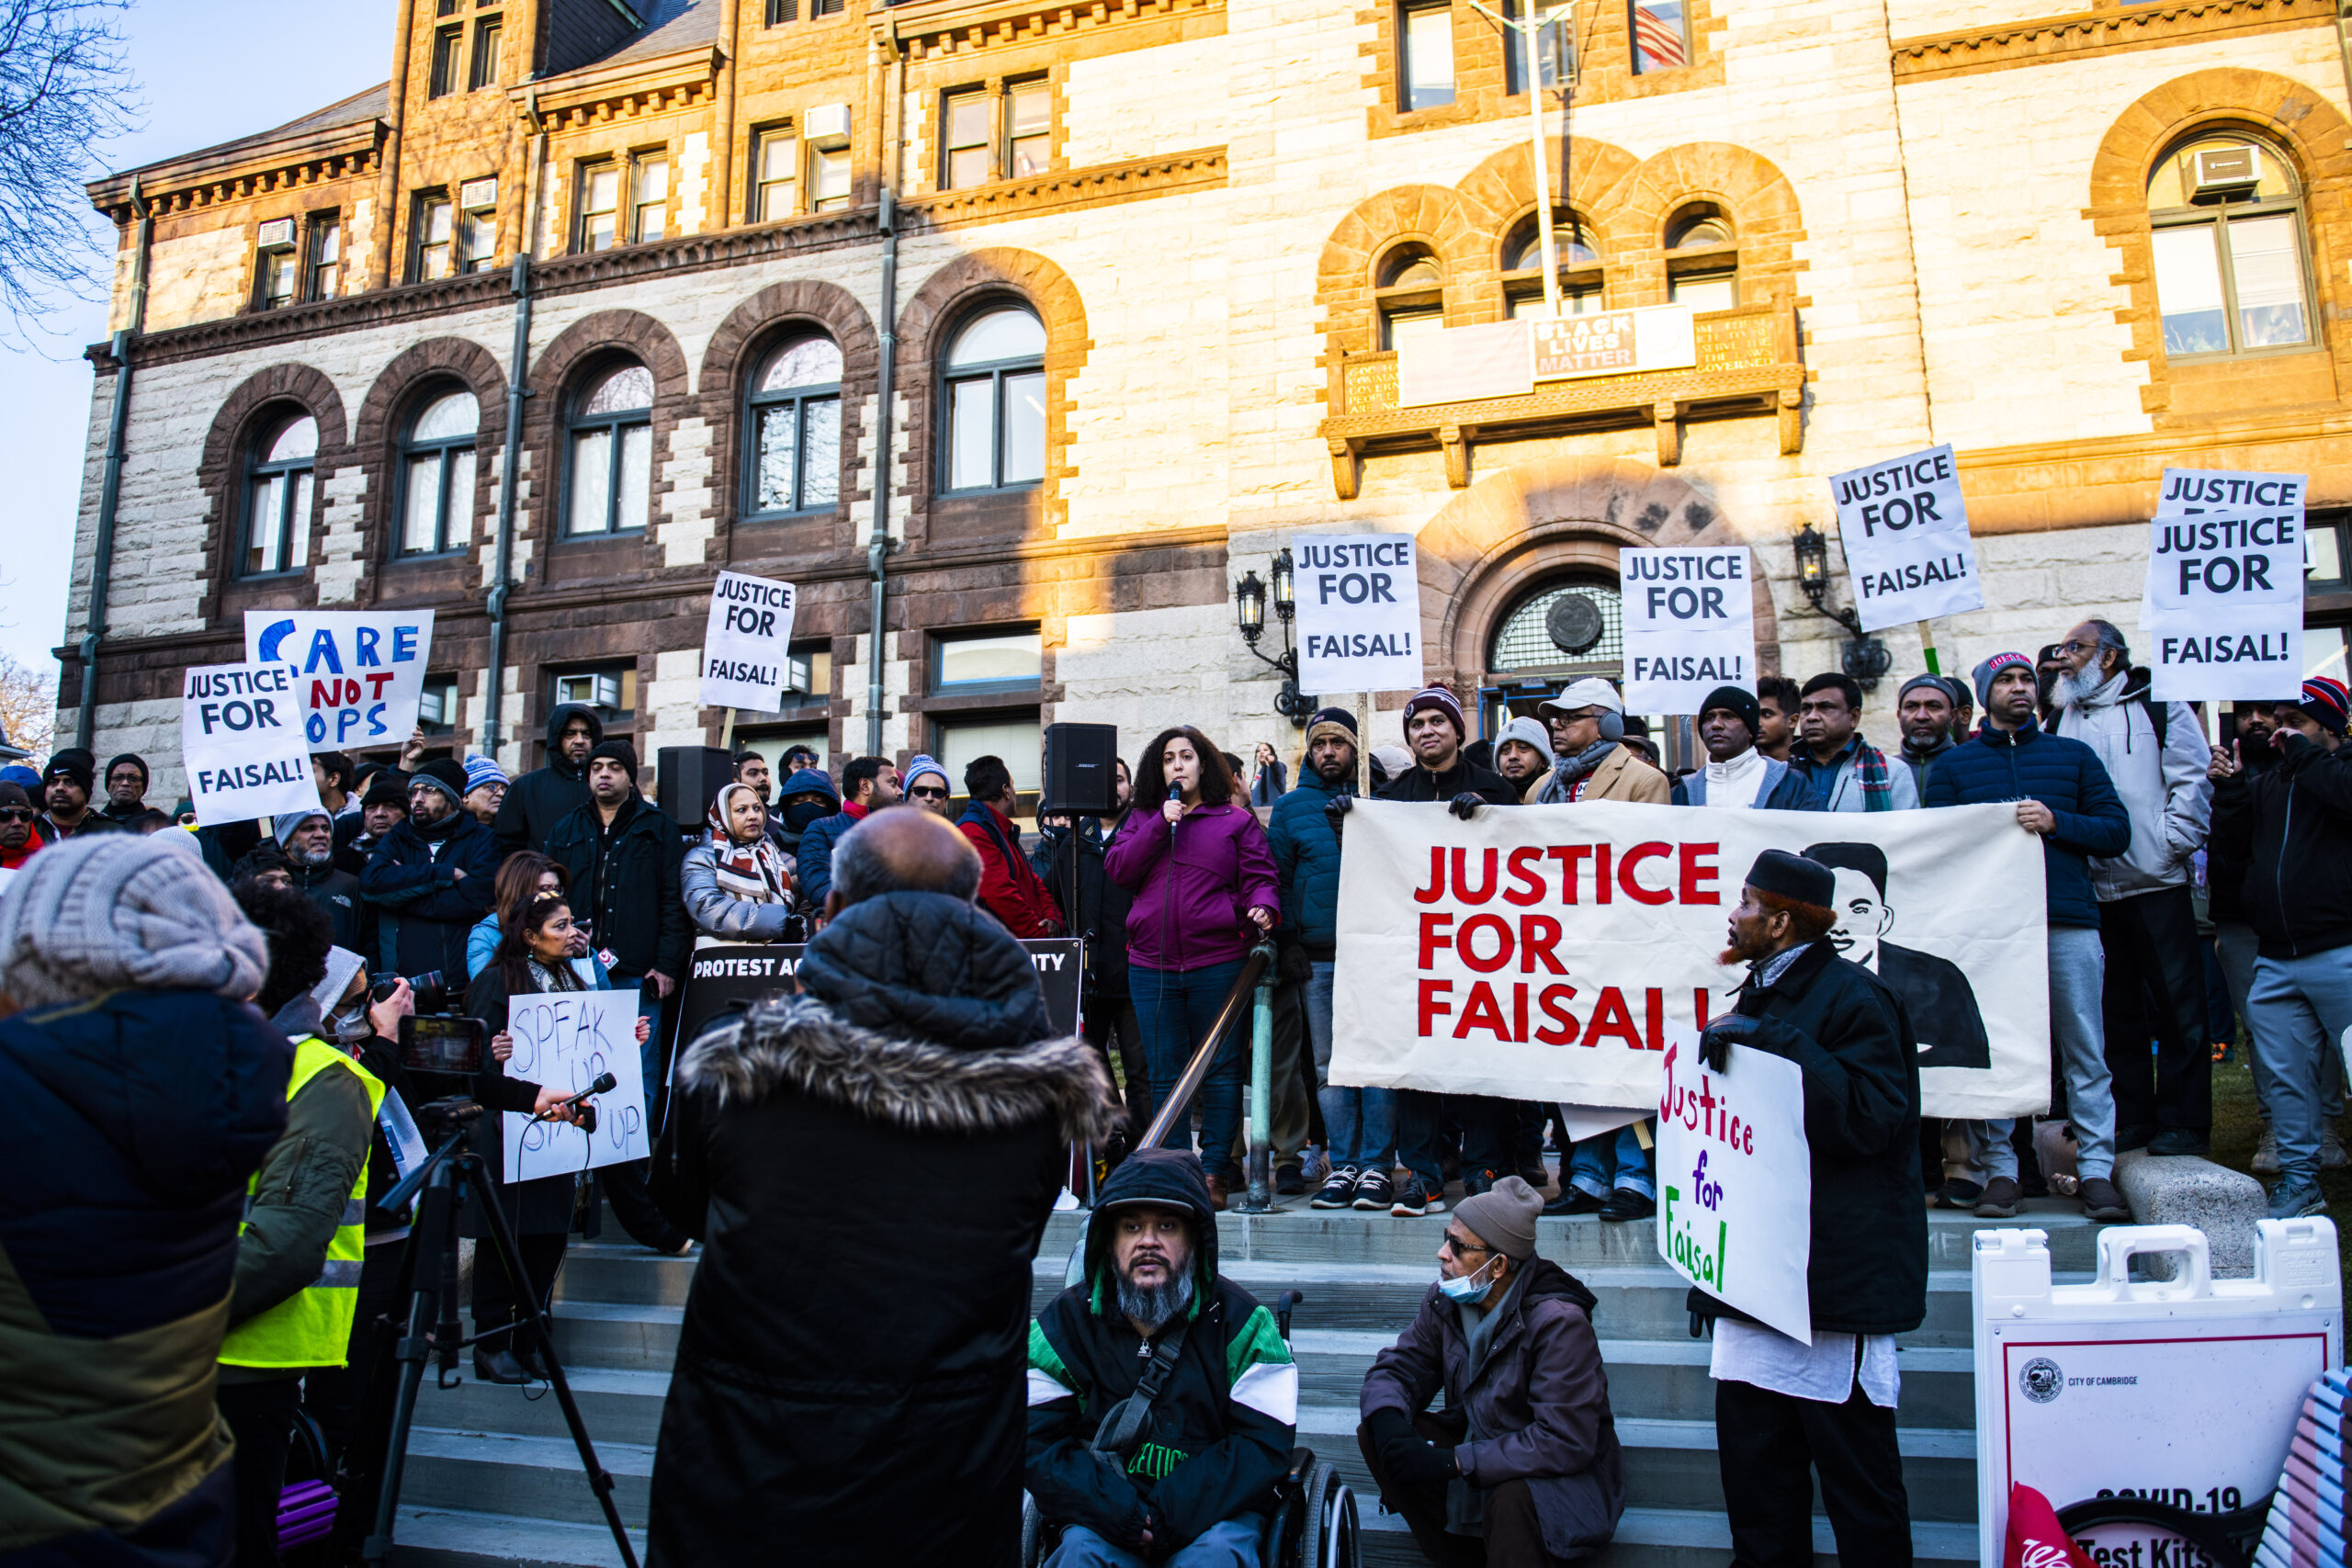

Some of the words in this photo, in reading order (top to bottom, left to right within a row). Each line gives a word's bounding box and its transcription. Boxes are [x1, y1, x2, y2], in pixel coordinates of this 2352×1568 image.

[1537, 316, 1631, 340] BLACK
[1549, 333, 1619, 355] LIVES
[1539, 349, 1632, 373] MATTER
[1696, 357, 1774, 374] GOVERNED
[1840, 454, 1951, 505] JUSTICE
[2165, 477, 2298, 507] JUSTICE
[1861, 491, 1943, 537] FOR
[2156, 515, 2294, 555] JUSTICE
[1298, 542, 1409, 569] JUSTICE
[1626, 556, 1742, 581] JUSTICE
[1318, 572, 1396, 604] FOR
[1860, 553, 1967, 599] FAISAL!
[2179, 554, 2274, 595] FOR
[718, 579, 792, 609] JUSTICE
[1647, 586, 1728, 619] FOR
[725, 604, 775, 637] FOR
[258, 619, 419, 677] CARE
[1307, 632, 1412, 659] FAISAL!
[2163, 632, 2289, 664] FAISAL!
[187, 669, 288, 699] JUSTICE
[709, 659, 777, 686] FAISAL!
[1634, 656, 1742, 681] FAISAL!
[310, 671, 394, 709] NOT
[200, 698, 282, 735] FOR
[305, 702, 388, 744] OPS
[198, 758, 304, 794] FAISAL!
[1413, 840, 1721, 907] JUSTICE
[1417, 911, 1570, 975] FOR
[693, 958, 775, 979] PROTEST
[513, 999, 614, 1078] SPEAK
[1659, 1041, 1754, 1156] Justice
[609, 1105, 640, 1156] UP
[1692, 1149, 1724, 1212] for
[1665, 1185, 1727, 1293] Faisal
[2068, 1377, 2085, 1386] CITY
[2086, 1377, 2095, 1386] OF
[2096, 1376, 2138, 1386] CAMBRIDGE
[2076, 1540, 2143, 1568] Test
[2151, 1539, 2213, 1568] Kits
